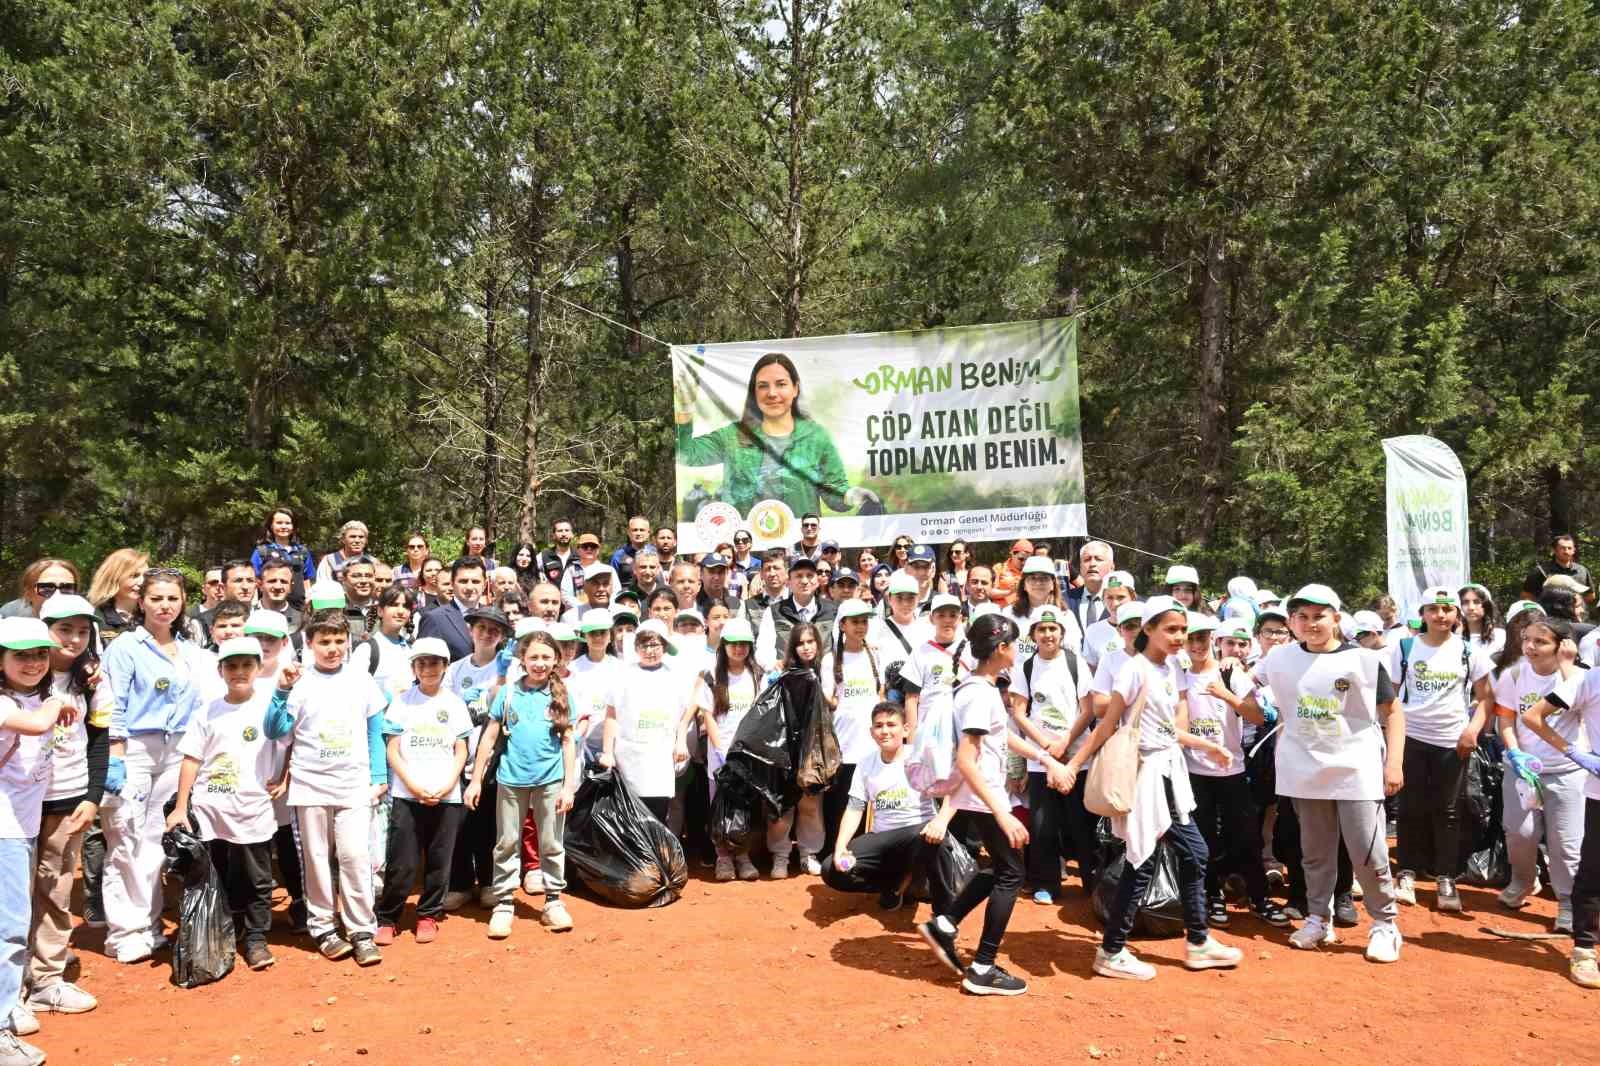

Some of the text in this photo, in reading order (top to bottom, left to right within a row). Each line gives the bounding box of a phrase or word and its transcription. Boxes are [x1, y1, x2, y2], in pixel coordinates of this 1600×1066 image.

[856, 361, 953, 396] ORMAN
[866, 410, 912, 447] ÇÖP
[920, 408, 979, 440] ATAN
[866, 443, 977, 477] TOPLAYAN
[920, 510, 1048, 527] Orman Genel Müdürlüğü
